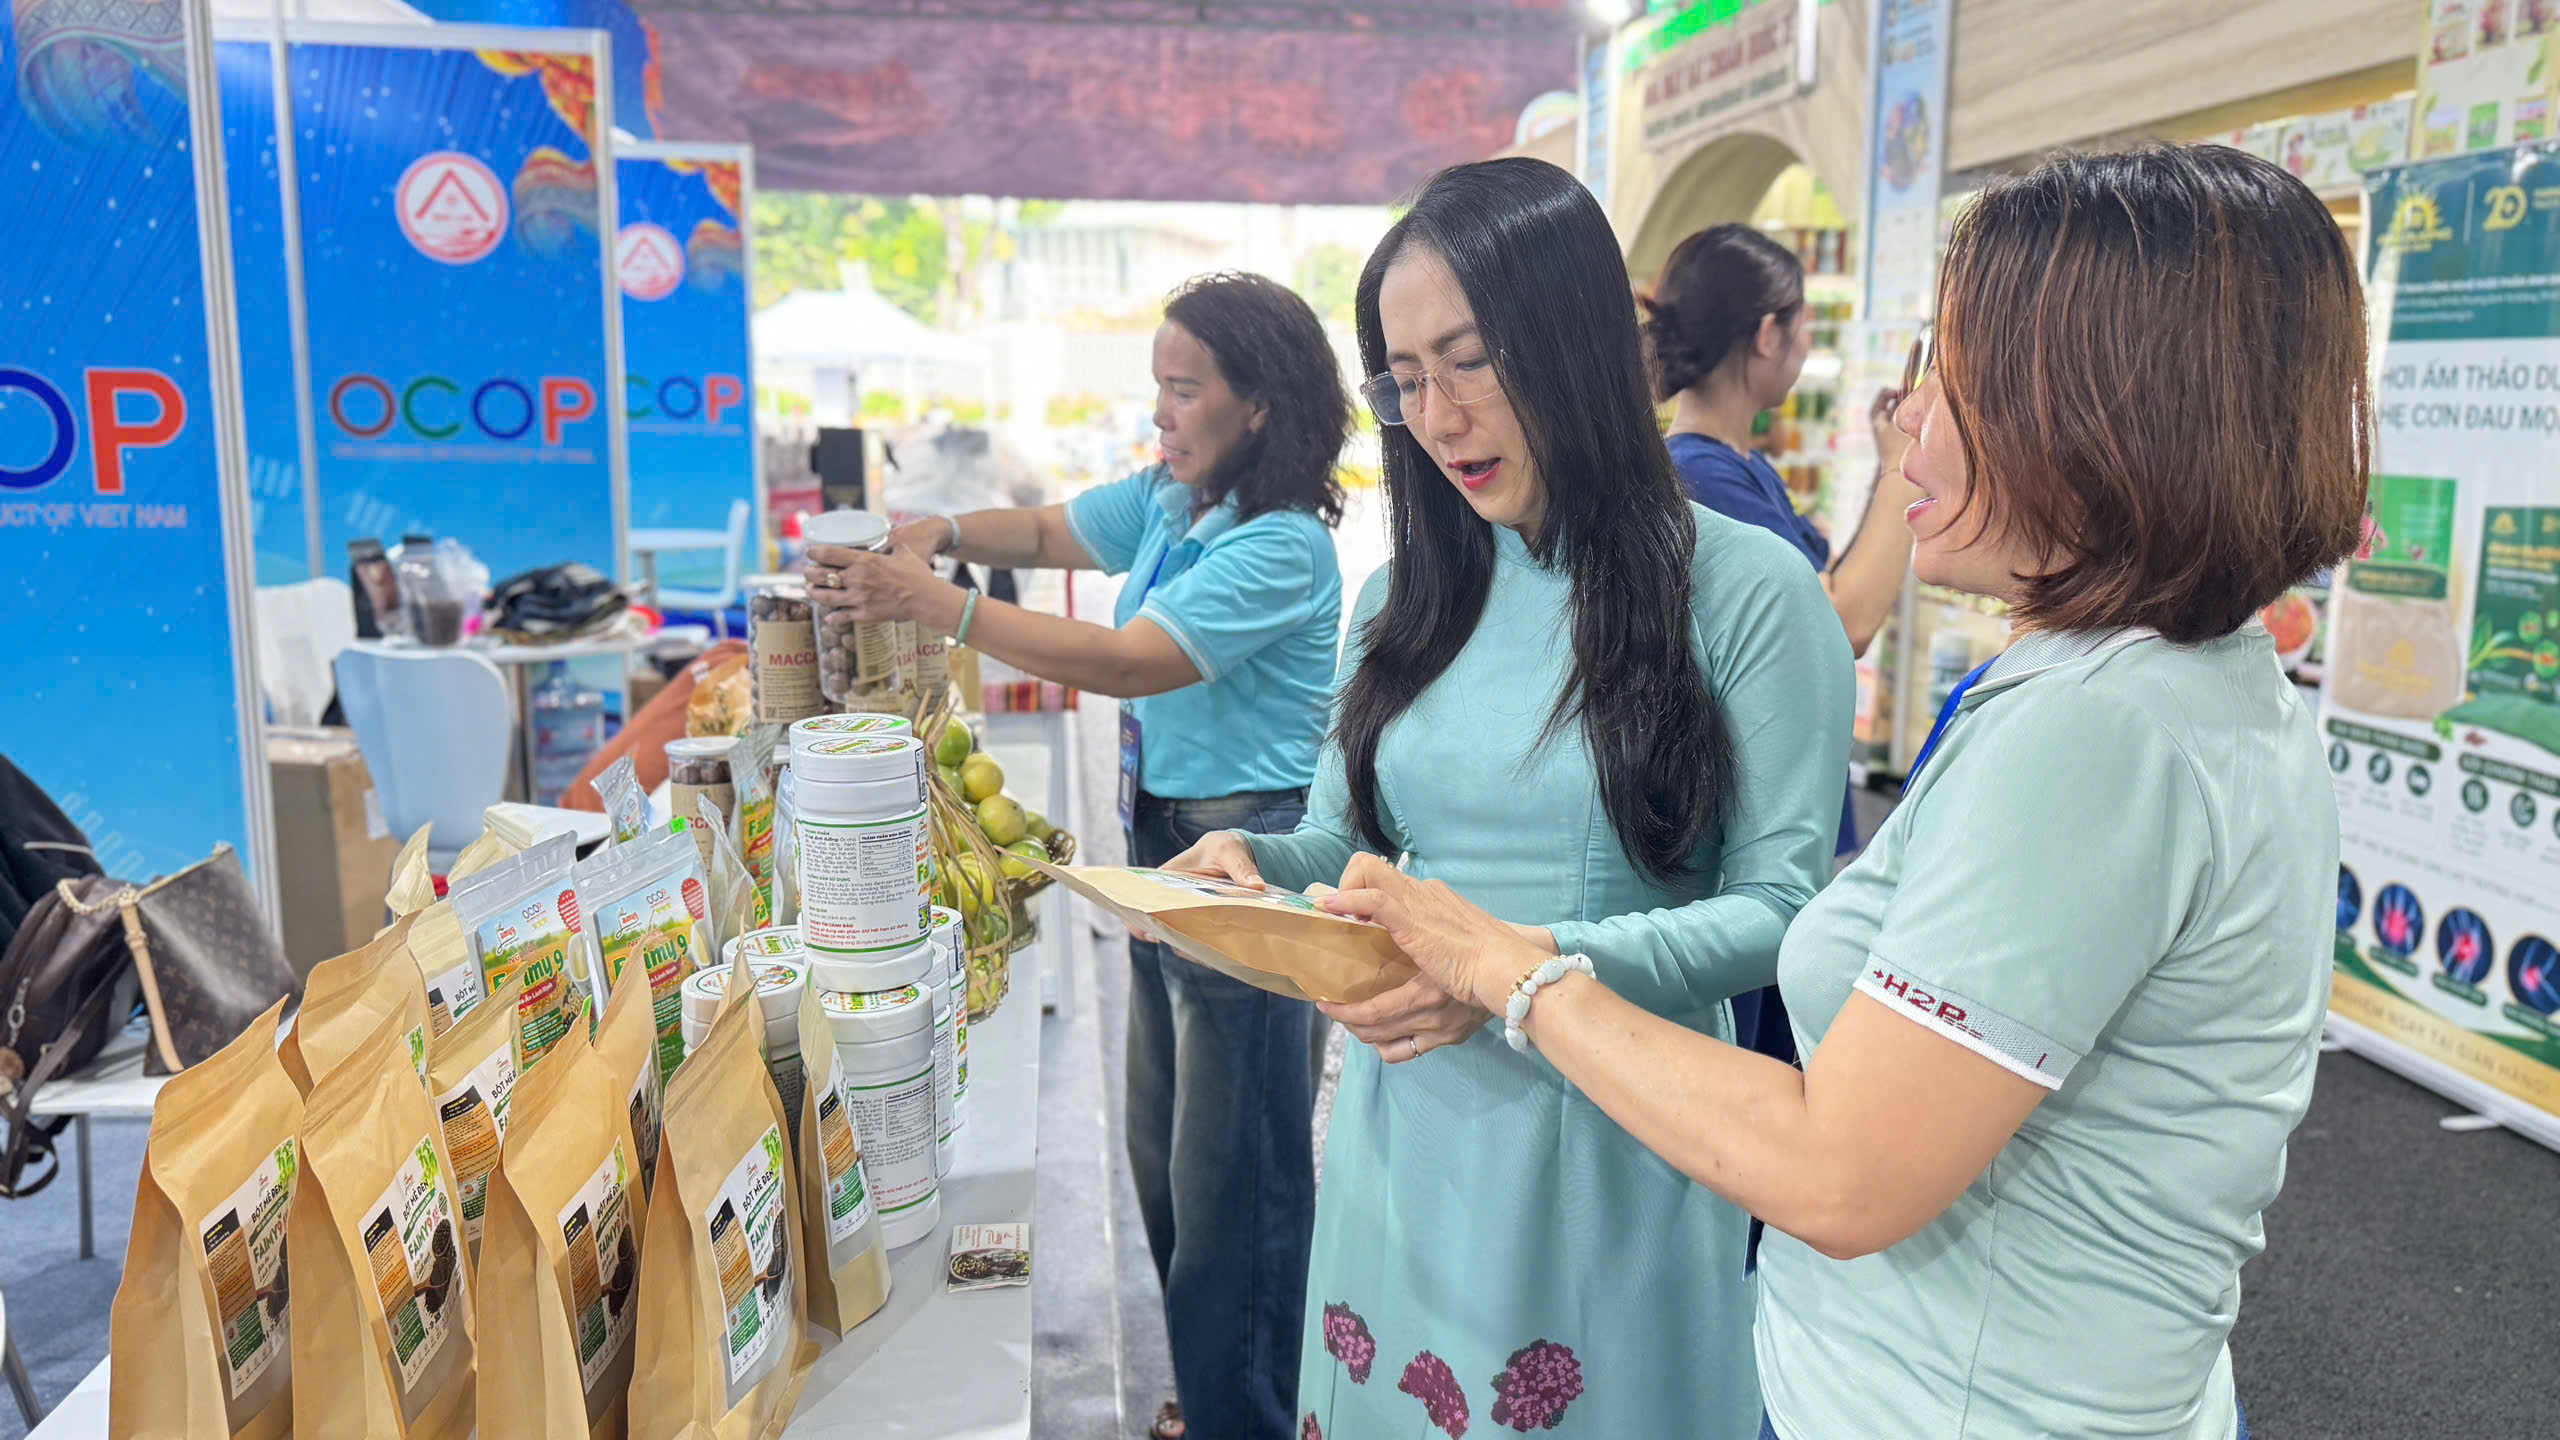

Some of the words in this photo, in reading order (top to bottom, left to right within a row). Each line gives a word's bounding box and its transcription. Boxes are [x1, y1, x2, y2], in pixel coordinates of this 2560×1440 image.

[330, 373, 596, 444] OCOP
[42, 504, 75, 528] OF
[80, 504, 132, 528] VIET
[136, 504, 188, 528] NAM
[1883, 973, 1968, 1020] H2P
[403, 1199, 414, 1221] BỘT
[743, 1189, 755, 1212] BỘT
[251, 1202, 265, 1223] BỘT
